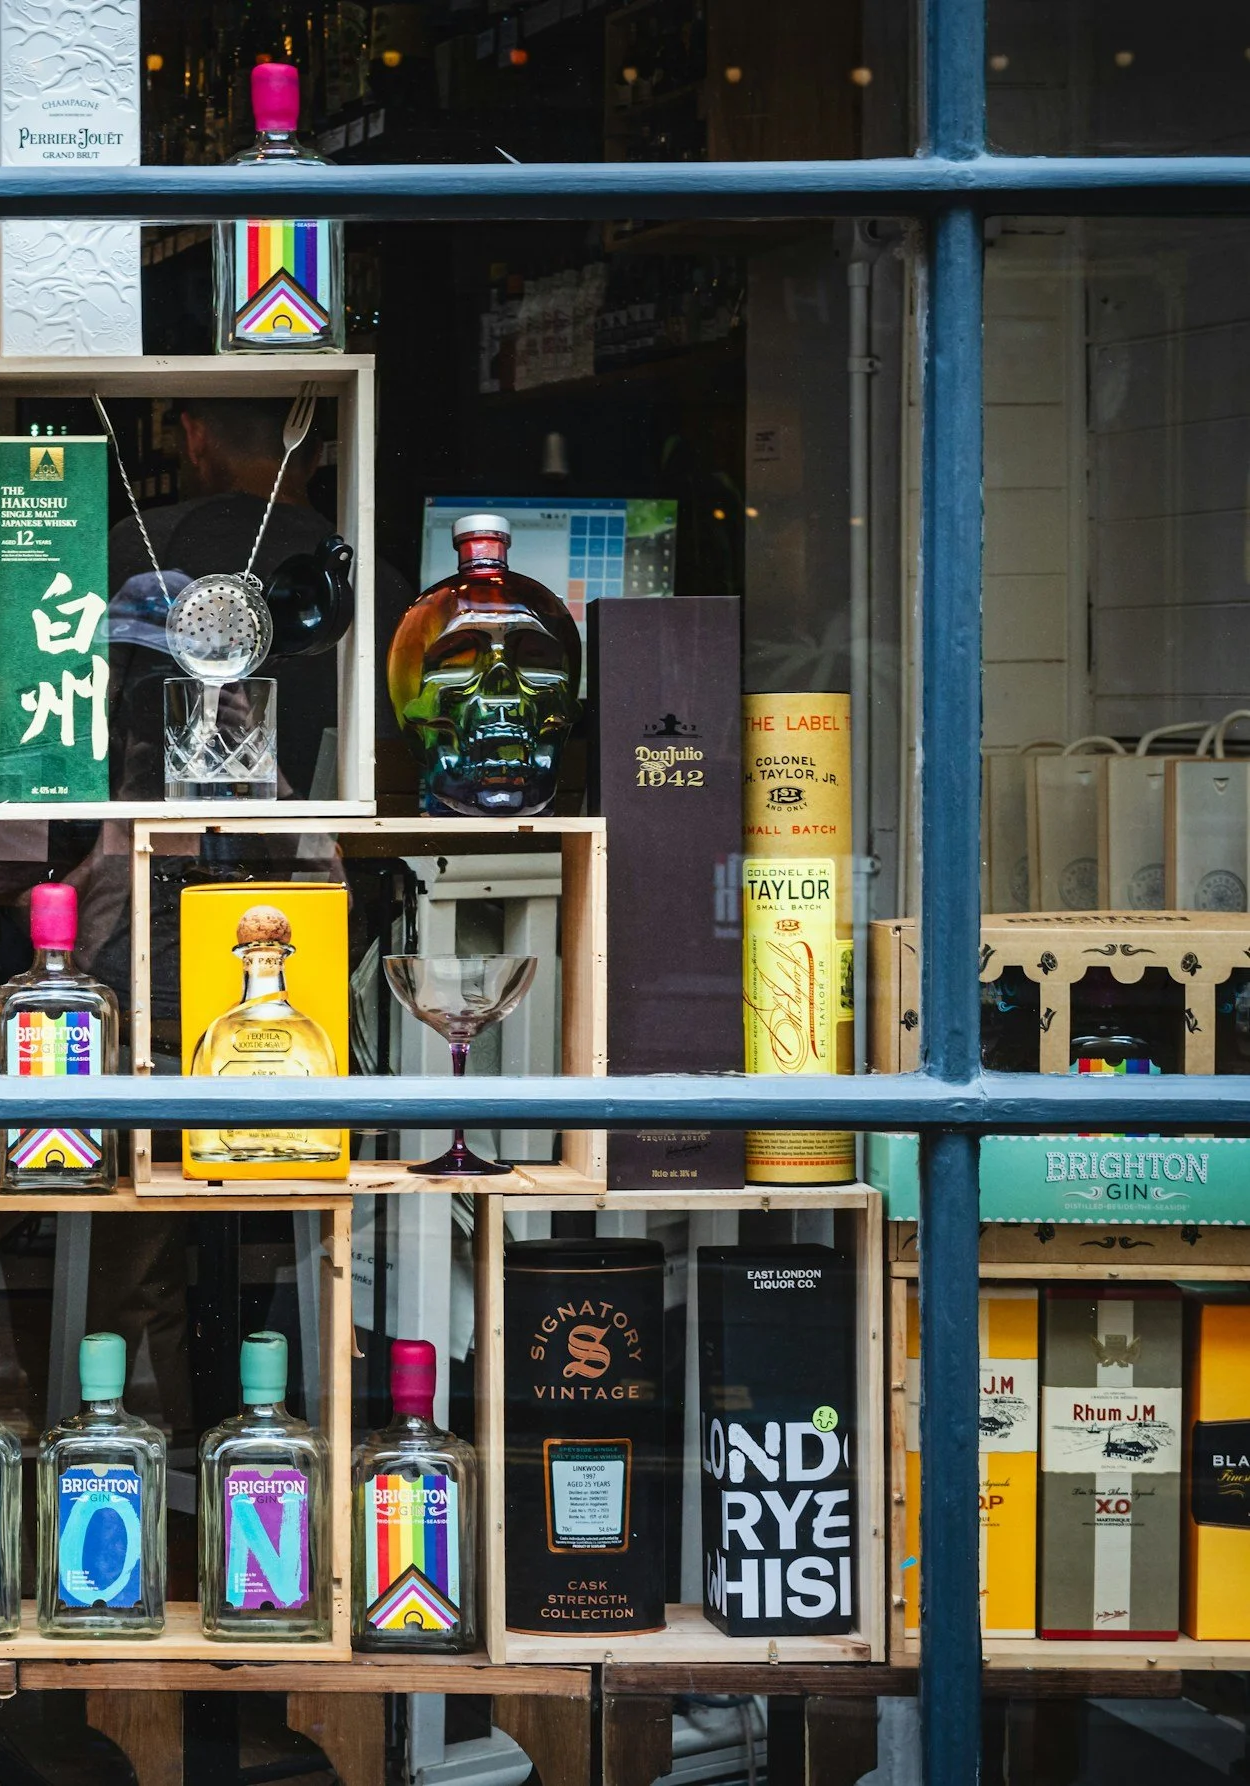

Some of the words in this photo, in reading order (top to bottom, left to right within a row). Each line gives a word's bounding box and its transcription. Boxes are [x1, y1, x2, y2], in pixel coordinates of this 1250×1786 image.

[41, 99, 100, 111] CHAMPAGNE
[42, 151, 75, 160] GRAND
[76, 151, 100, 160] BRUT
[0, 486, 25, 495] THE
[0, 497, 68, 509] HAKUSHU
[0, 510, 33, 518] SINGLE
[34, 510, 59, 518] MALT
[0, 519, 43, 527] JAPANESE
[44, 519, 78, 527] WHISKY
[16, 530, 34, 546] 12
[19, 571, 110, 762] 白州
[743, 716, 775, 731] THE
[786, 716, 840, 731] LABEL
[755, 756, 817, 767] COLONEL
[635, 769, 705, 787] 1942
[759, 768, 818, 783] TAYLOR,
[822, 773, 839, 787] JR.
[765, 803, 783, 812] AND
[786, 802, 809, 812] ONLY
[792, 825, 837, 834] BATCH
[807, 868, 830, 876] E.H.
[747, 879, 830, 901] TAYLOR
[15, 1026, 94, 1042] BRIGHTON
[247, 1032, 281, 1041] TEQUILA
[1045, 1152, 1210, 1184] BRIGHTON
[1106, 1183, 1148, 1200] GIN
[747, 1270, 774, 1280] EAST
[776, 1269, 822, 1279] LONDON
[753, 1280, 796, 1290] LIQUOR
[797, 1279, 817, 1289] CO.
[530, 1300, 643, 1362] SIGNATORY
[983, 1376, 1015, 1395] J.M
[534, 1385, 640, 1400] VINTAGE
[1073, 1403, 1122, 1422] Rhum
[1126, 1404, 1156, 1422] J.M
[702, 1411, 849, 1484] LOND
[61, 1478, 139, 1495] BRIGHTON
[228, 1480, 306, 1496] BRIGHTON
[89, 1493, 111, 1502] GIN
[256, 1495, 278, 1504] GIN
[373, 1488, 451, 1505] BRIGHTON
[721, 1489, 850, 1551] RYE
[1096, 1517, 1130, 1526] MARTINIQUE
[567, 1580, 608, 1591] CASK
[547, 1594, 627, 1605] STRENGTH
[540, 1608, 634, 1620] COLLECTION
